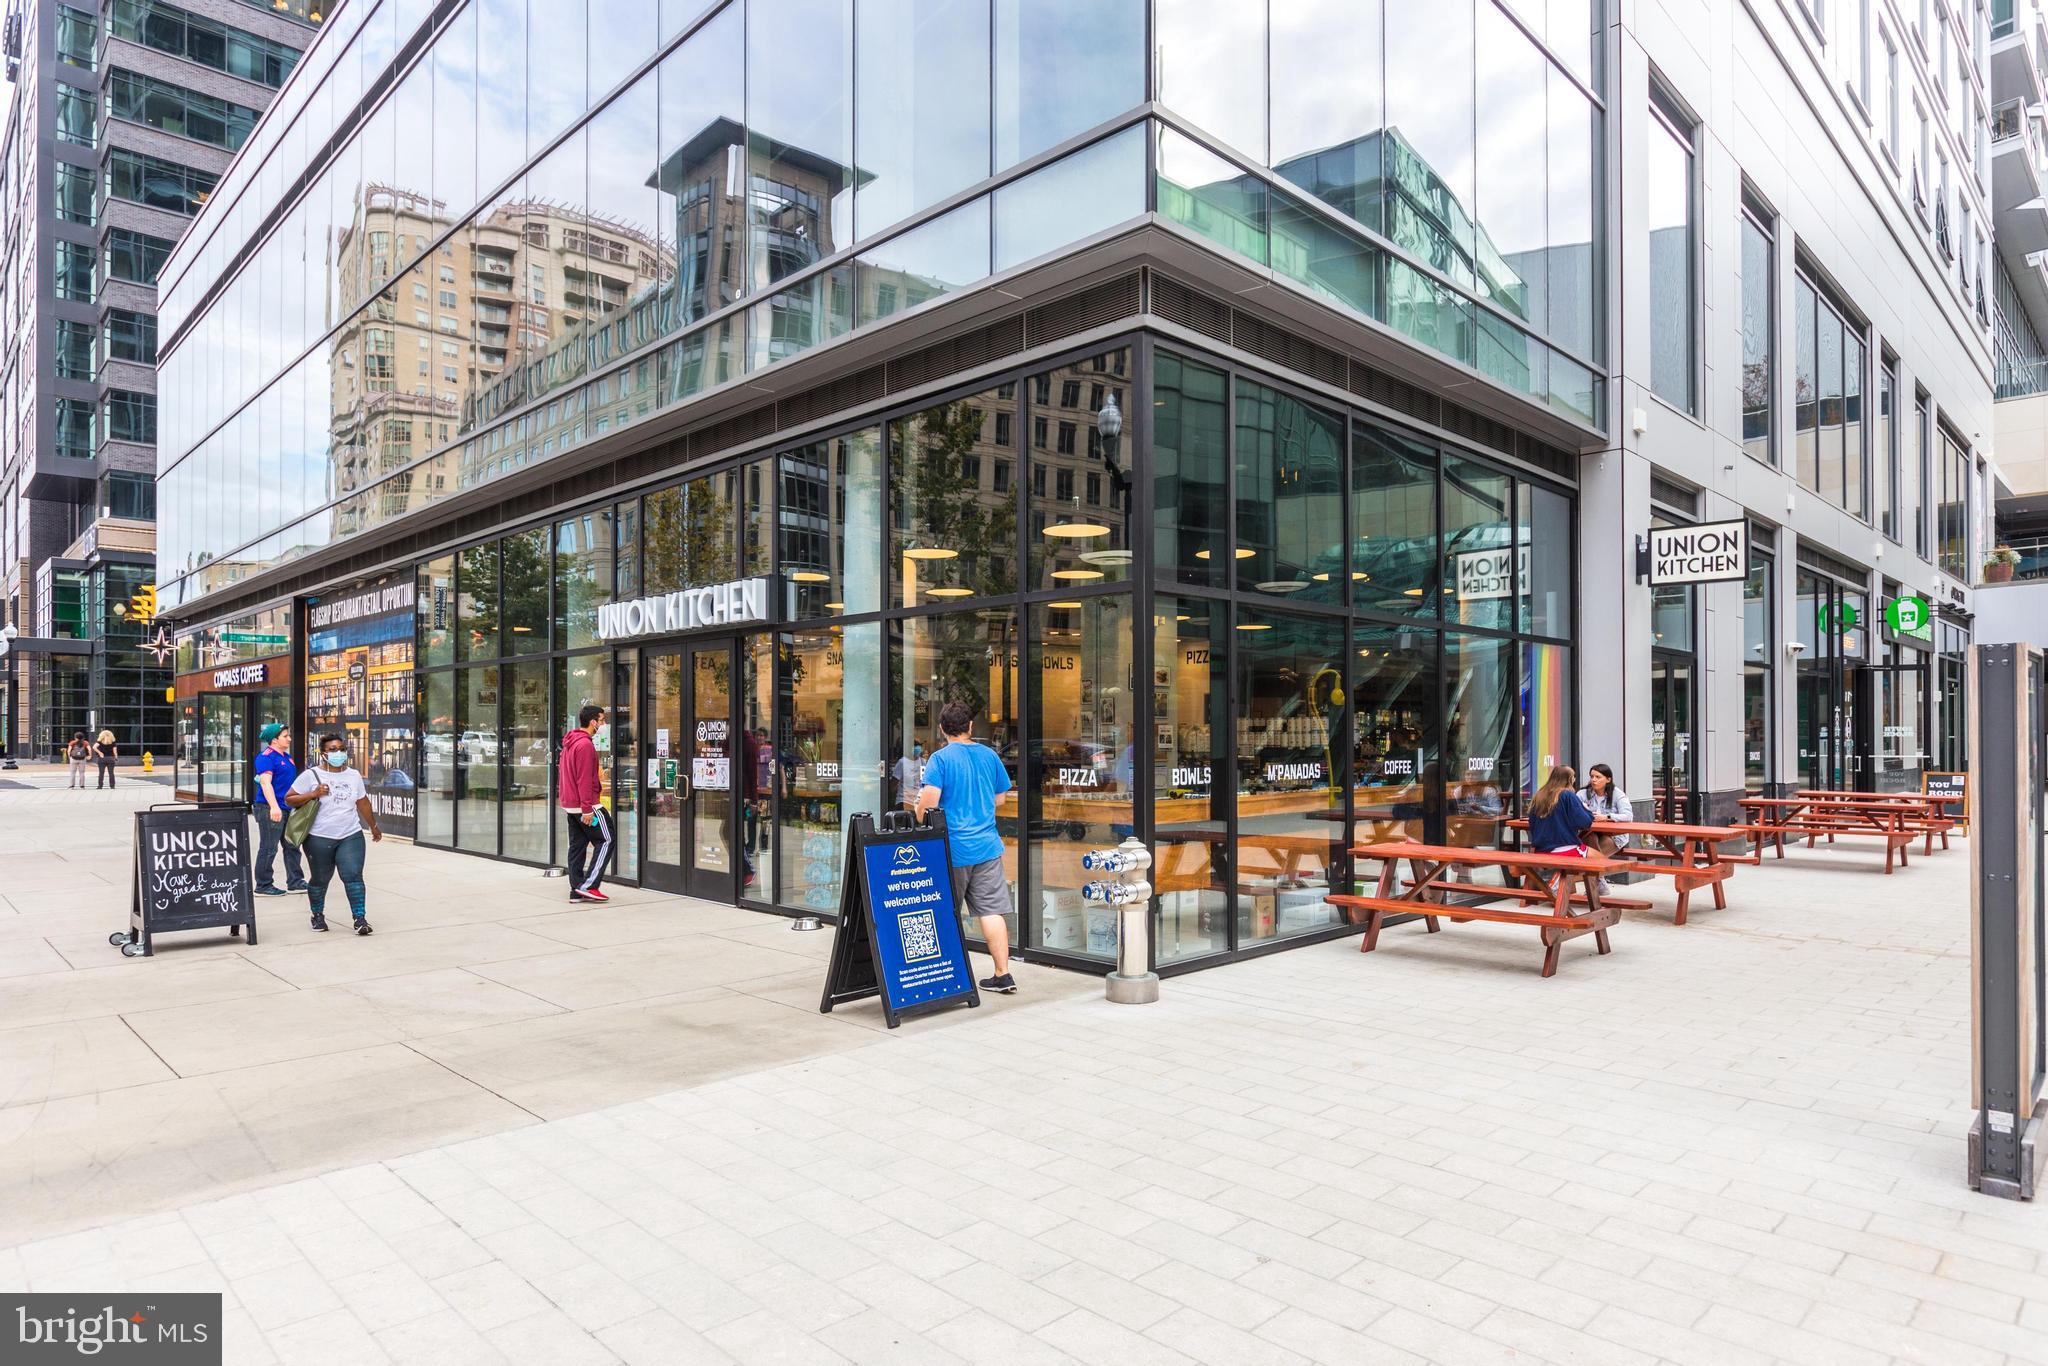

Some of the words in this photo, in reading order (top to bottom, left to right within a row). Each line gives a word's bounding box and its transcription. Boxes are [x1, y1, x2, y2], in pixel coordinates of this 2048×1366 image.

[1658, 530, 1738, 557] UNION
[1658, 554, 1738, 576] KITCHEN
[311, 605, 331, 628] FLAGSHIP
[382, 582, 414, 612] OPPORTUNI
[598, 597, 665, 640] UNION
[666, 578, 766, 630] KITCHEN
[827, 652, 844, 665] SNA
[1040, 656, 1074, 670] OWLS
[1186, 650, 1209, 664] PIZZ
[214, 669, 240, 688] COMPASS
[240, 664, 265, 684] COFFEE
[708, 721, 726, 732] UNION
[708, 732, 726, 740] KITCHEN
[816, 762, 838, 777] BEER
[1384, 760, 1412, 774] COFFEE
[1468, 758, 1493, 770] COOKIES
[1544, 755, 1554, 767] ATM
[1059, 768, 1098, 786] PIZZA
[1172, 767, 1212, 786] BOWLS
[1267, 763, 1320, 780] M'PANADAS
[152, 829, 237, 852] UNION
[154, 850, 238, 870] KITCHEN
[890, 866, 927, 876] #inthistogether
[152, 871, 192, 892] Have
[198, 873, 208, 883] a
[888, 881, 910, 891] we're
[910, 877, 933, 890] open!
[172, 882, 206, 903] great
[884, 897, 920, 908] welcome
[921, 891, 941, 902] back
[220, 901, 239, 912] UK
